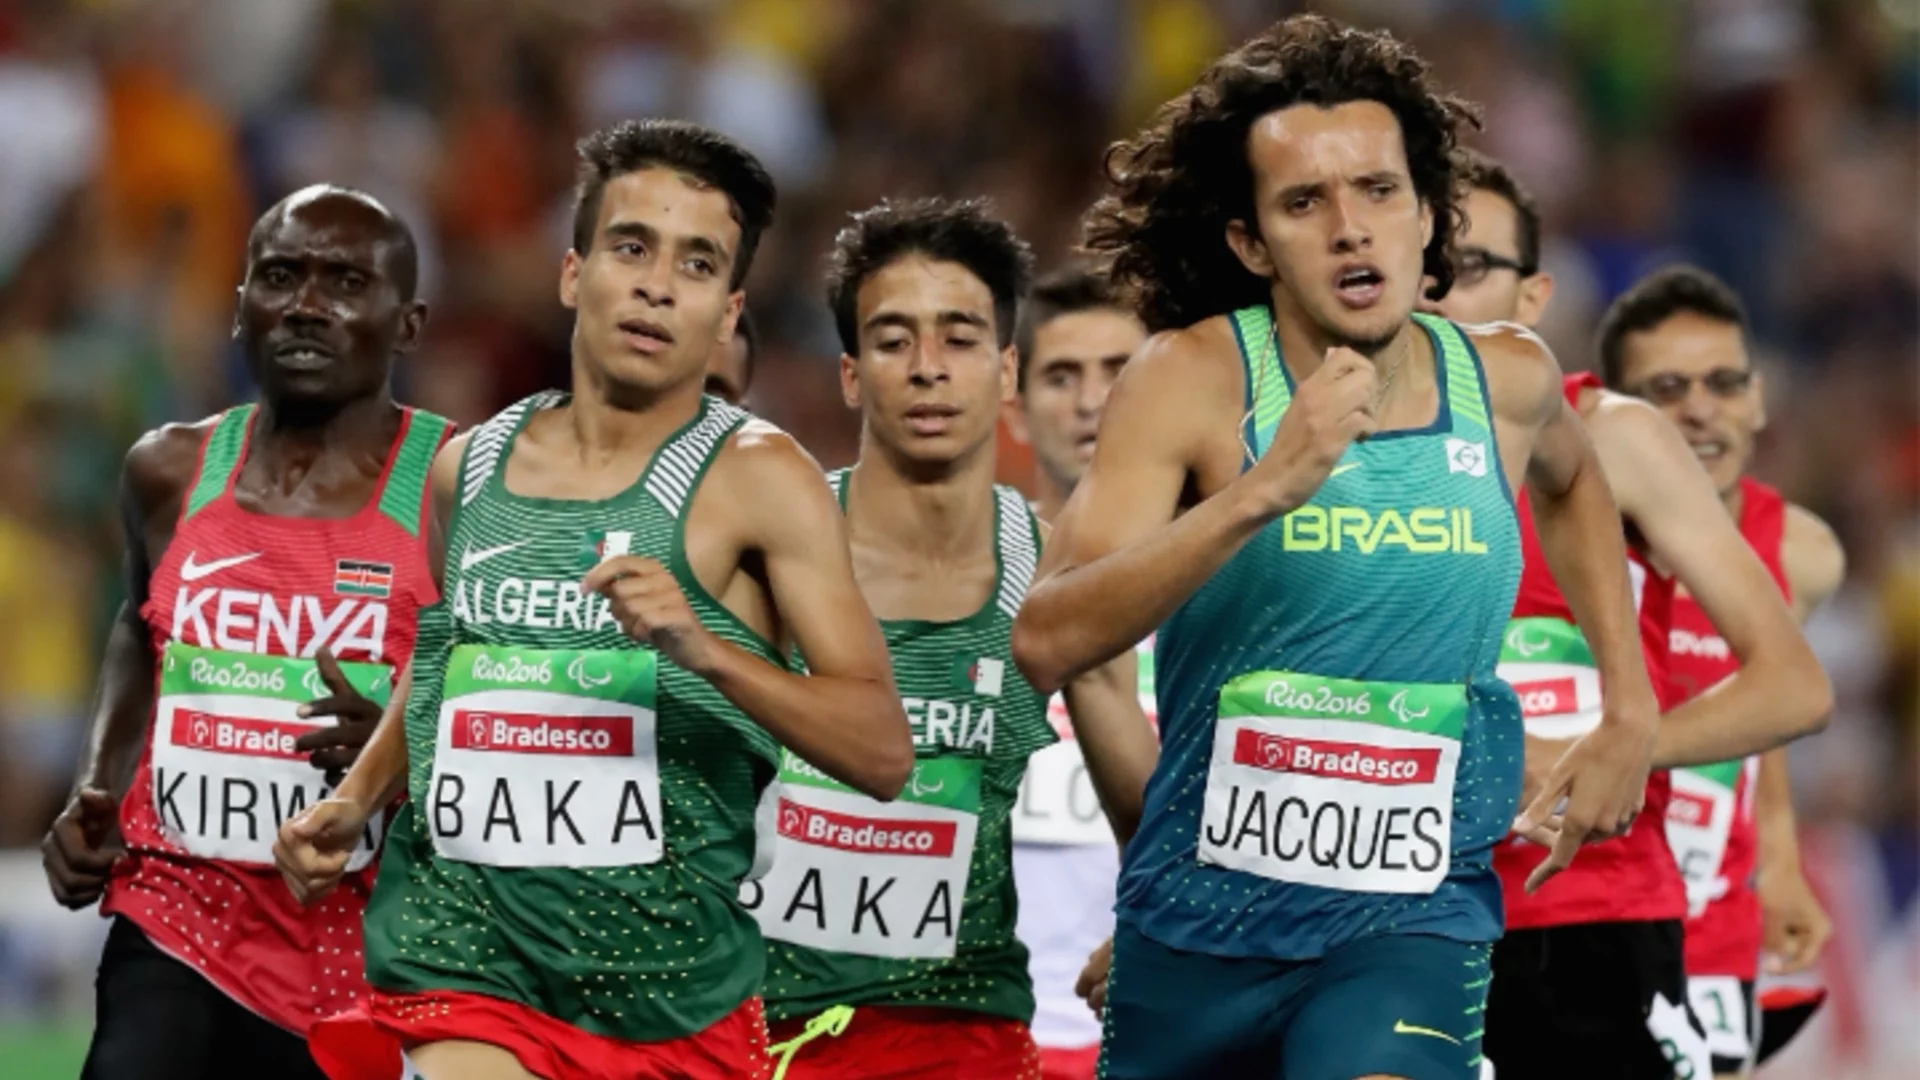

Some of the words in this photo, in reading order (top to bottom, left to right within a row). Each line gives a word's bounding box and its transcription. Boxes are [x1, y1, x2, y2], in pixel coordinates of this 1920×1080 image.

[1283, 506, 1488, 554] BRASIL
[172, 586, 388, 663] KENYA
[453, 577, 624, 633] ALGERIA
[216, 722, 296, 752] Brade
[492, 719, 610, 749] Bradesco
[902, 697, 995, 754] ERIA
[1293, 745, 1418, 779] Bradesco
[157, 767, 374, 850] KIRW
[434, 772, 657, 845] BAKA
[807, 815, 934, 849] Bradesco
[1206, 785, 1442, 872] JACQUES
